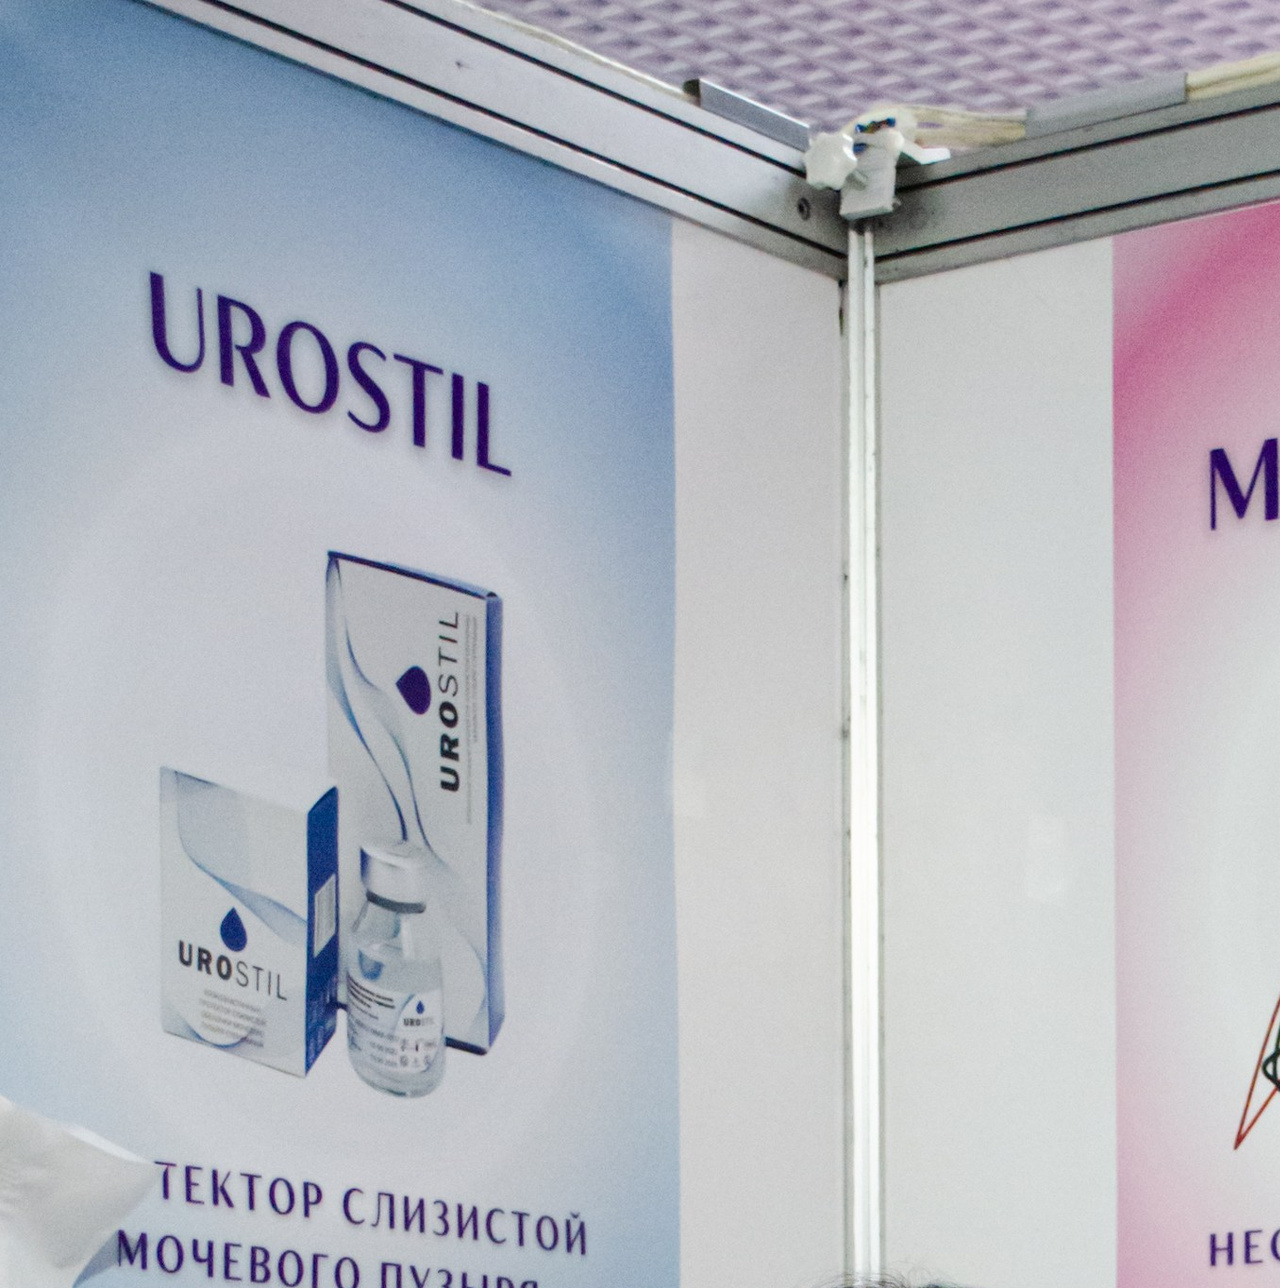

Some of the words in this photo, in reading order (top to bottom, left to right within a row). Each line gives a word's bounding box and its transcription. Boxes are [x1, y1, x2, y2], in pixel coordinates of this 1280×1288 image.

[149, 270, 513, 477] UROSTIL
[438, 611, 461, 793] UROSTIL
[178, 939, 288, 1002] UROSTIL
[343, 1186, 588, 1257] СЛИЗИСТОЙ
